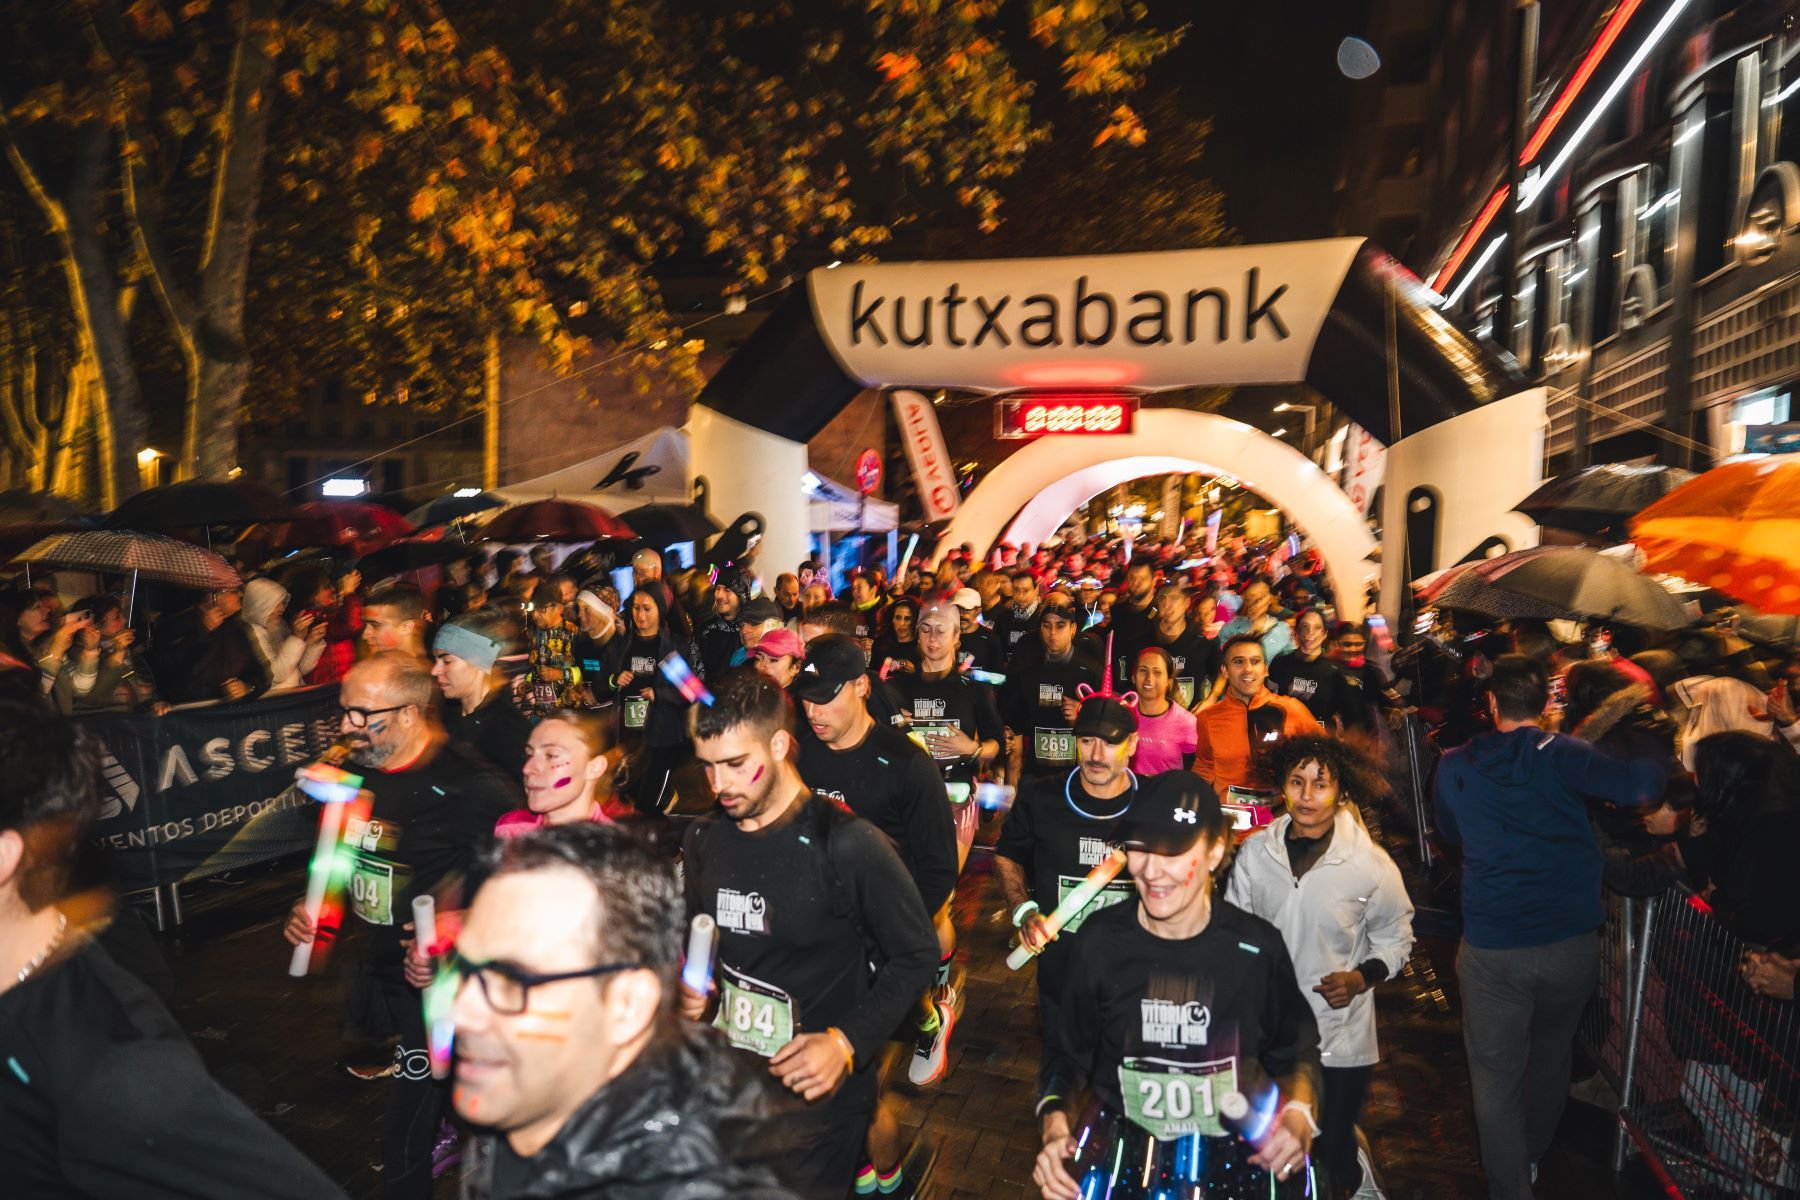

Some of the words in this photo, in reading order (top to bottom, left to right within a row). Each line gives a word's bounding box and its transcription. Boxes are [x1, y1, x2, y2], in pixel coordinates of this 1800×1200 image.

[849, 265, 1290, 347] kutxabank
[1040, 736, 1069, 752] 269
[1141, 1004, 1188, 1024] VITORIA
[1142, 1023, 1178, 1043] NIGHT
[1181, 1024, 1207, 1045] RUN
[1139, 1078, 1214, 1119] 201
